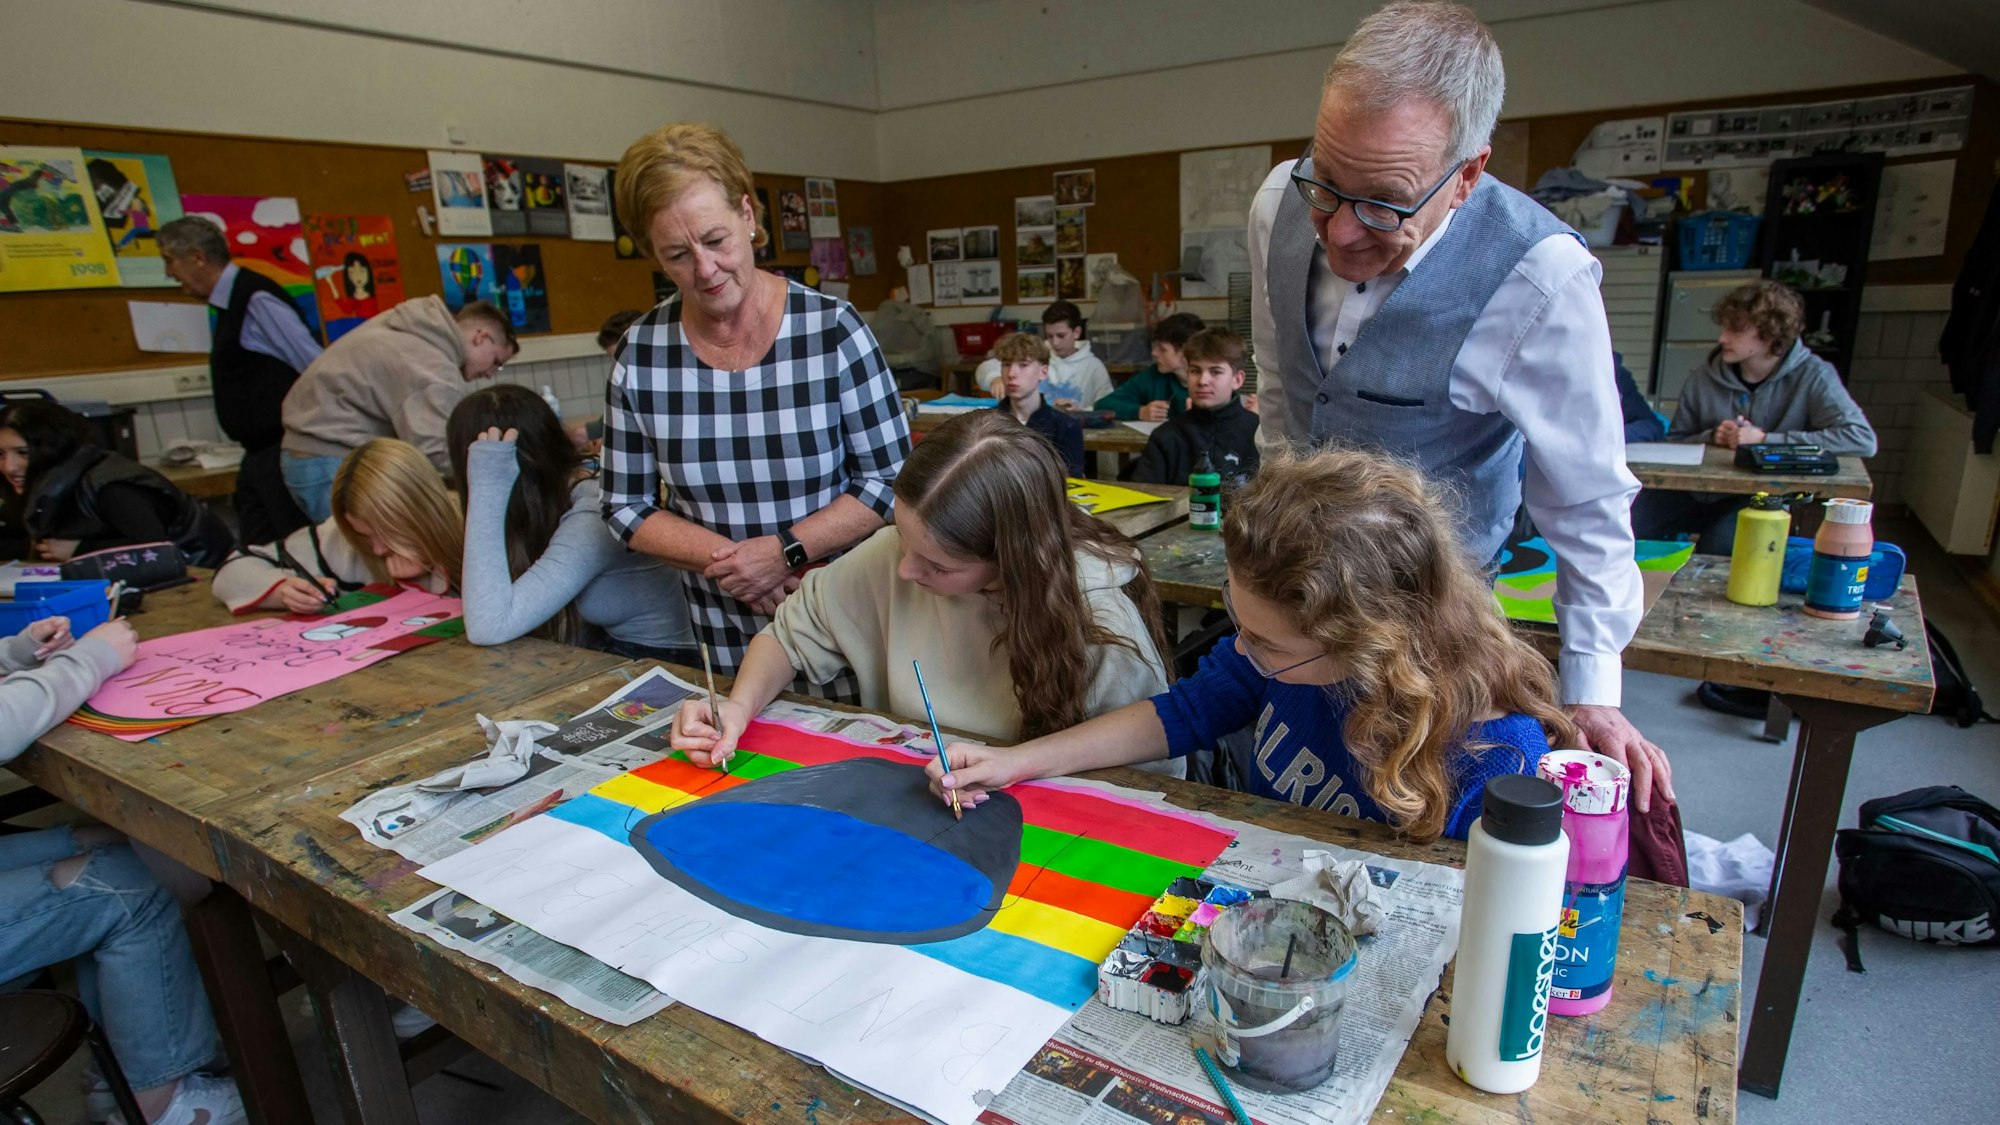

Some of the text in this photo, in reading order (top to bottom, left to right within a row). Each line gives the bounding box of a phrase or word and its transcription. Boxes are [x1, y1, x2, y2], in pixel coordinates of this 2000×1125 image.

[69, 263, 108, 277] 1998
[114, 657, 262, 716] BUN
[1880, 911, 1996, 945] NIKE
[1516, 924, 1559, 1060] boesner
[1085, 1055, 1095, 1064] zu
[1095, 1060, 1109, 1070] den
[1110, 1066, 1148, 1086] schönsten
[1148, 1081, 1225, 1117] Weihnachtsmärkten
